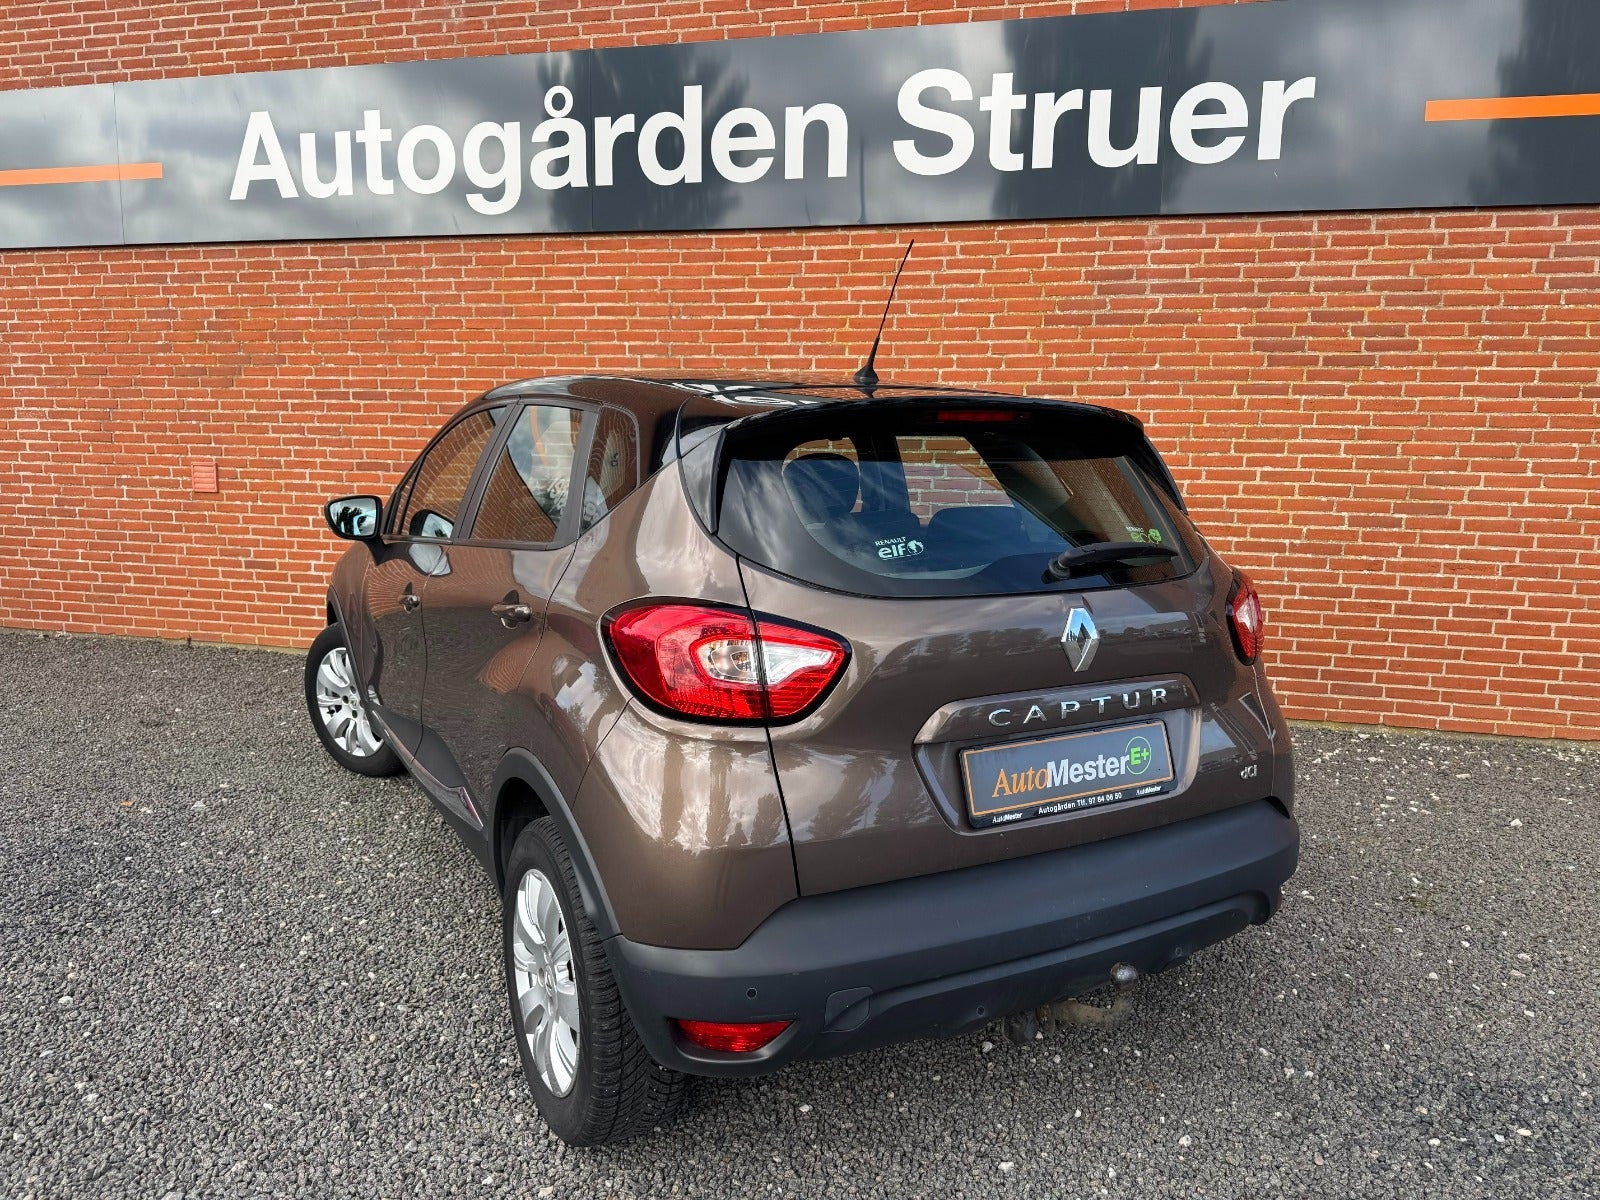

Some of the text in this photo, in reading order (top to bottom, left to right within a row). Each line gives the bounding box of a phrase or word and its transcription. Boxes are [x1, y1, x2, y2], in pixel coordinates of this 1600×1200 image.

[229, 68, 1316, 216] Autogården Struer
[874, 536, 906, 547] RENAULT
[878, 543, 906, 559] elf
[988, 688, 1168, 727] CAPTUR
[991, 754, 1131, 798] AutoMester
[1038, 802, 1076, 815] Autogården
